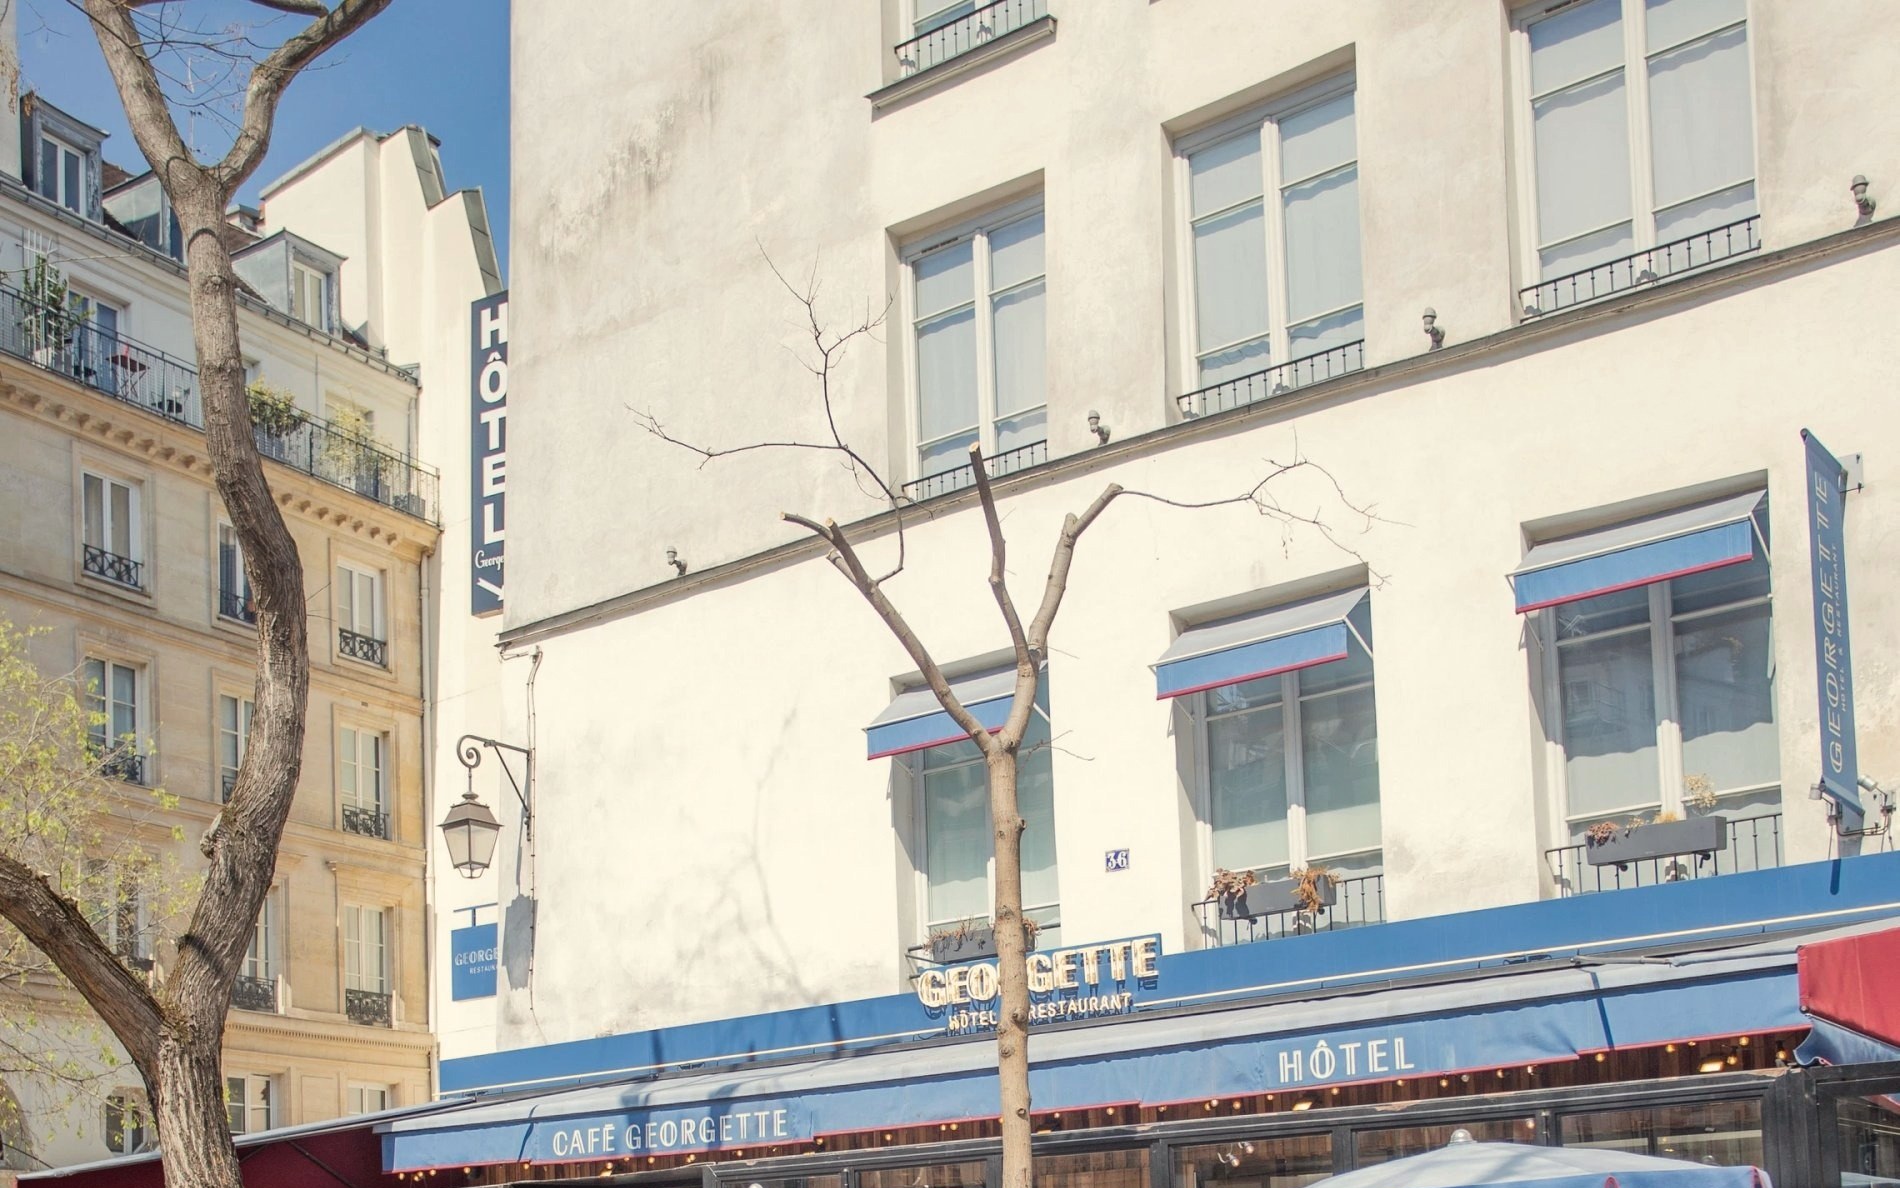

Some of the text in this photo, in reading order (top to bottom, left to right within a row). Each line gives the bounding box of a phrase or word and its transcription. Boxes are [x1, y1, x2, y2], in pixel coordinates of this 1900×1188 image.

[480, 301, 509, 545] HÔTEL
[1831, 543, 1842, 638] RESTAURANT
[1814, 471, 1843, 774] GEORGETTE
[1107, 851, 1127, 868] 36
[917, 938, 1160, 1007] GEOGETTE
[949, 990, 1132, 1031] HÔTEL RESTAURANT
[1279, 1037, 1415, 1084] HÔTEL
[553, 1108, 788, 1157] CAFÉ GEORGETTE
